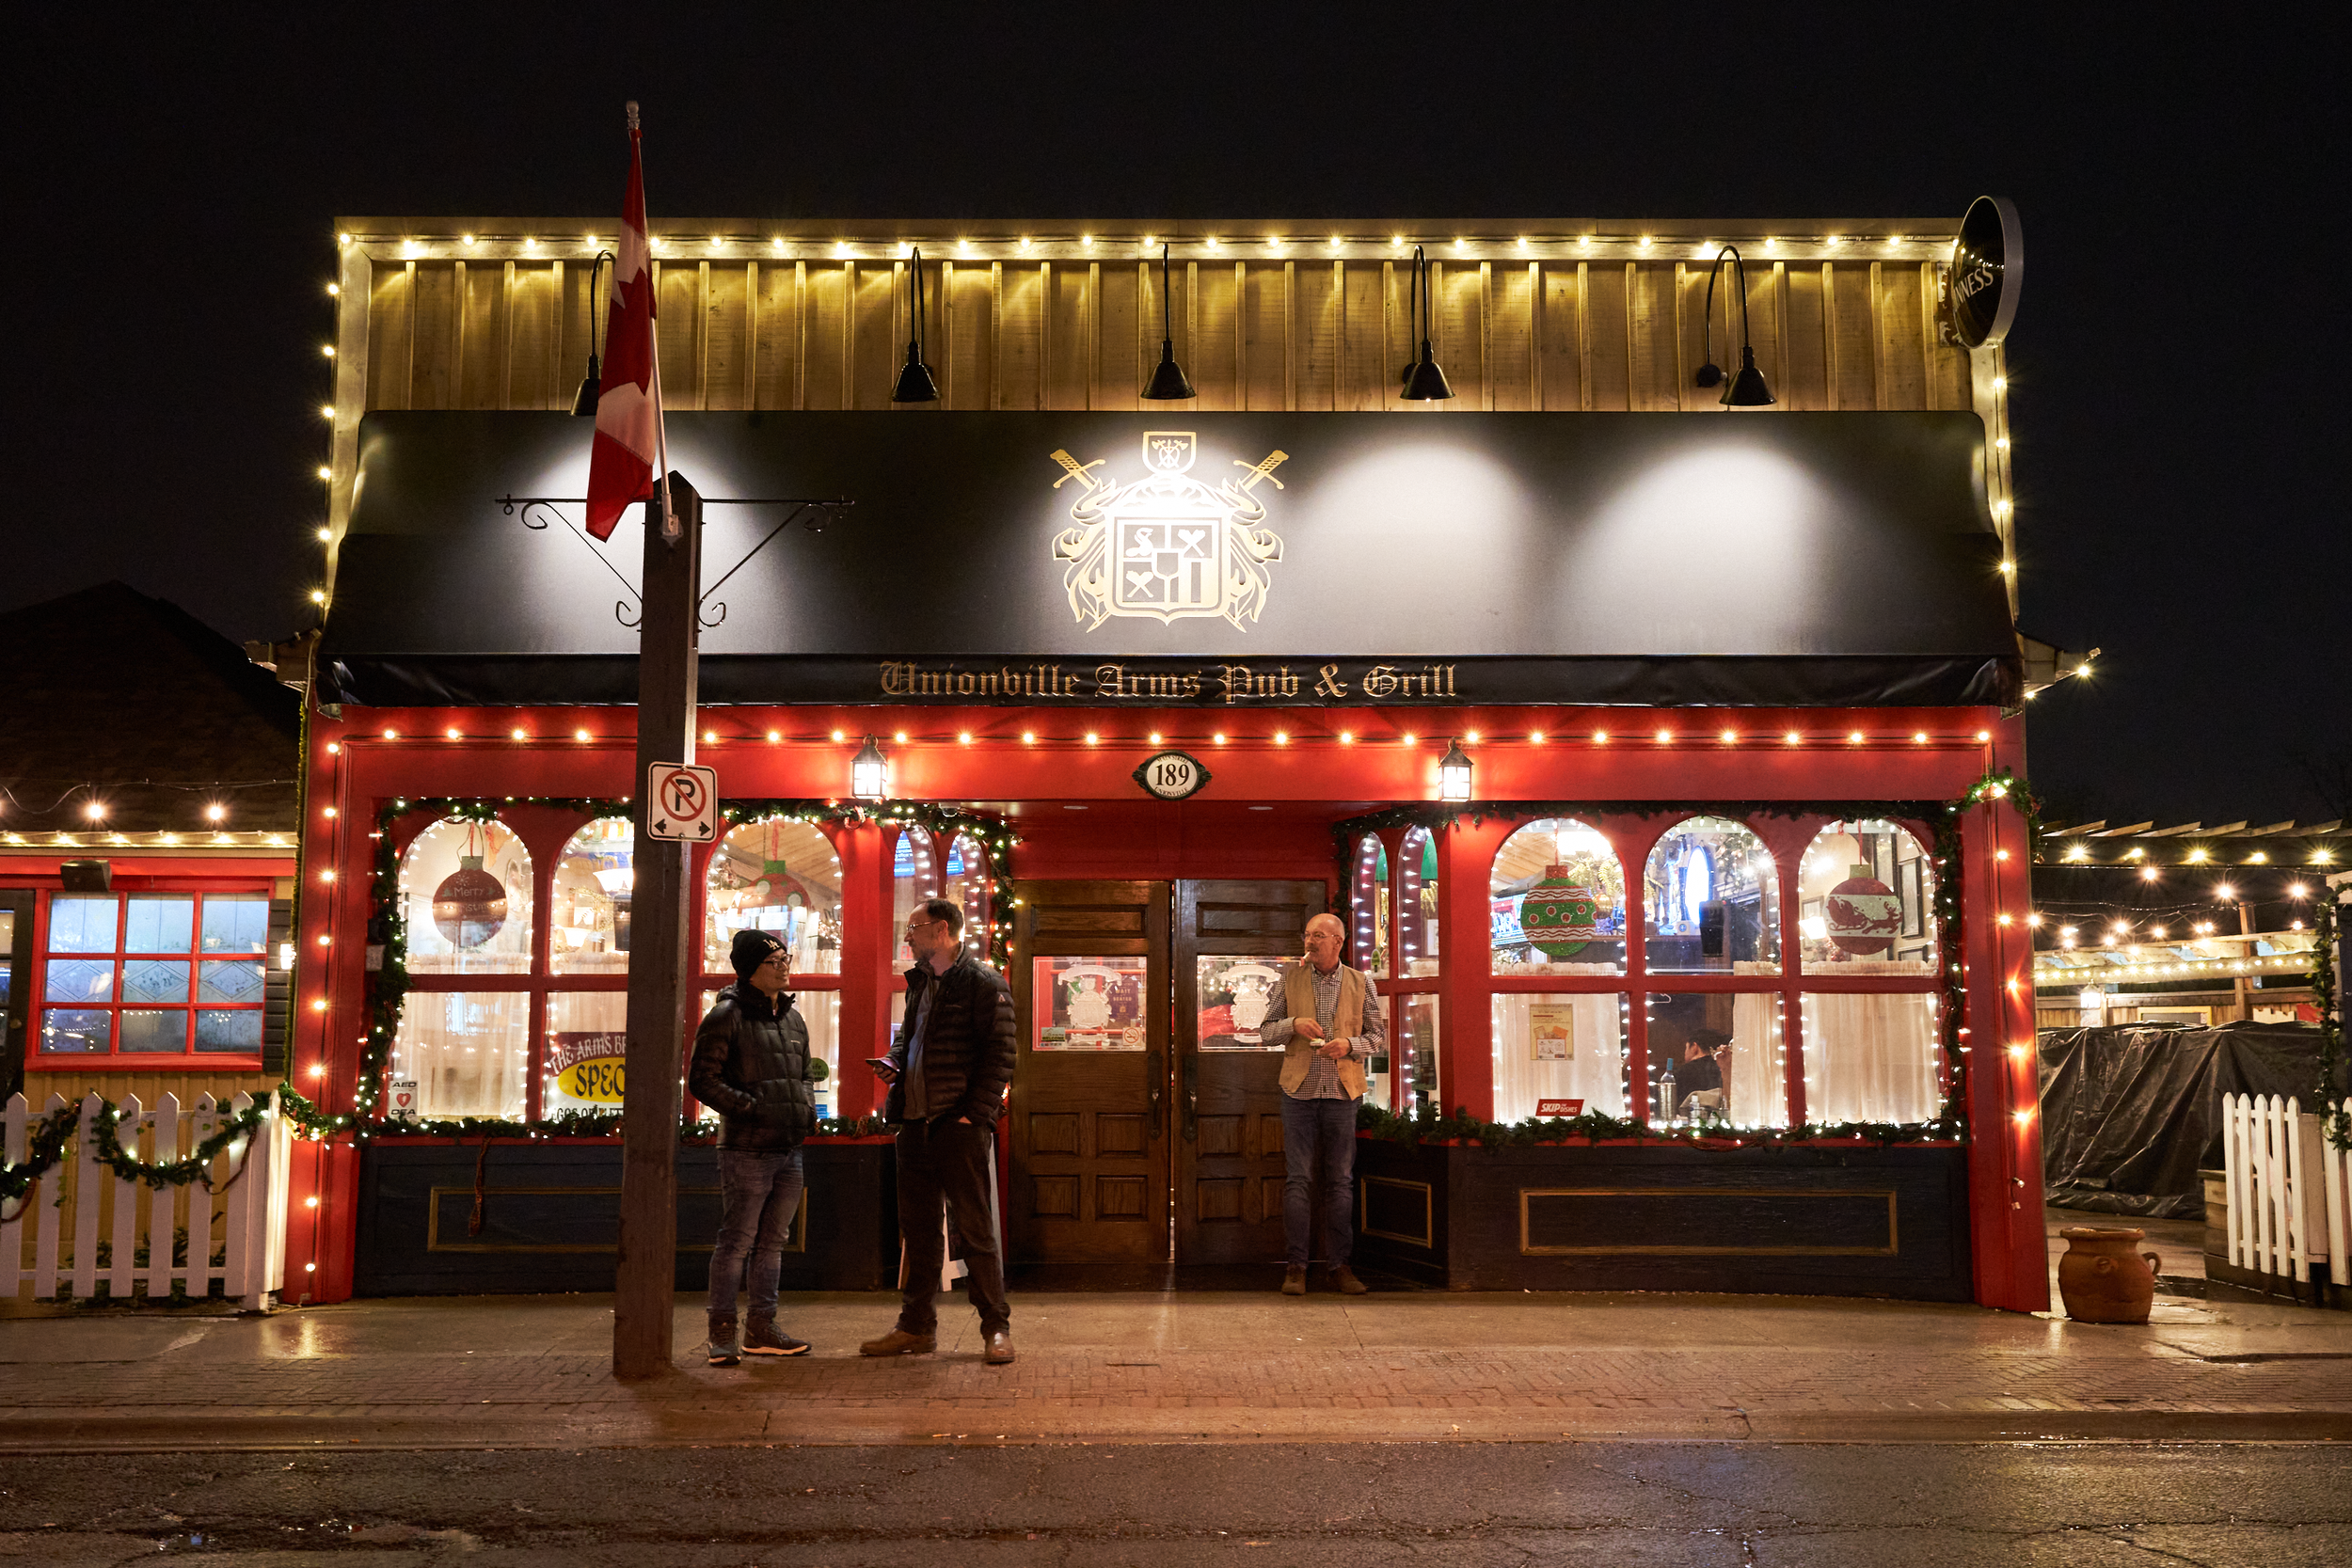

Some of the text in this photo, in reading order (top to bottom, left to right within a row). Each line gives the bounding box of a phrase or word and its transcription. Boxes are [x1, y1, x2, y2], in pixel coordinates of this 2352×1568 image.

[880, 660, 1456, 704] Unionville Arms Pub & Grill
[1155, 763, 1190, 786] 189
[453, 887, 484, 897] Merry
[763, 939, 780, 950] LA
[549, 1044, 574, 1075] THE
[577, 1036, 612, 1061] ARMS
[575, 1064, 625, 1098] SPEC
[1540, 1103, 1561, 1113] SKIP
